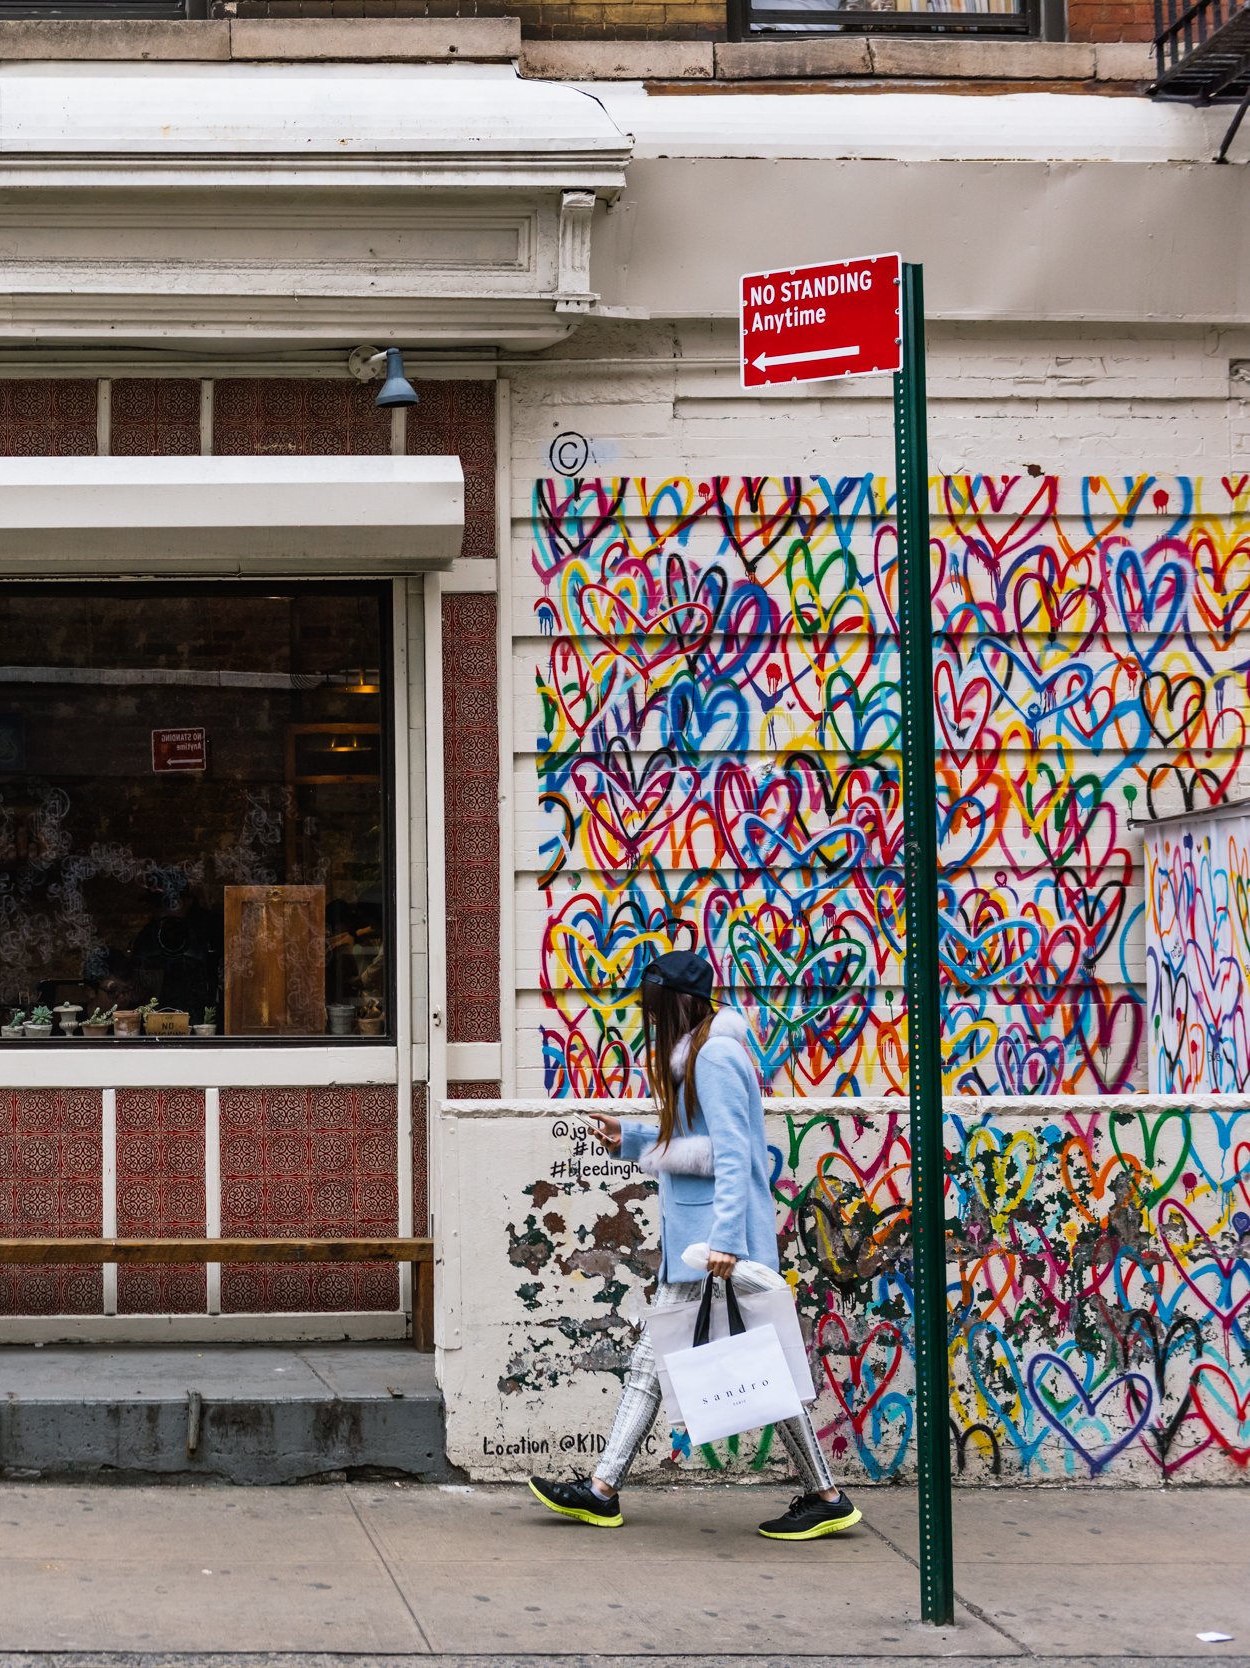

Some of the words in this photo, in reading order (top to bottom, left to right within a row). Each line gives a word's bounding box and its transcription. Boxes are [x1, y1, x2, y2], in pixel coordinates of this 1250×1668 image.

[750, 284, 776, 307] NO
[780, 270, 872, 303] STANDING
[751, 305, 827, 334] Anytime
[702, 1379, 769, 1405] sandro
[483, 1436, 549, 1456] Location
